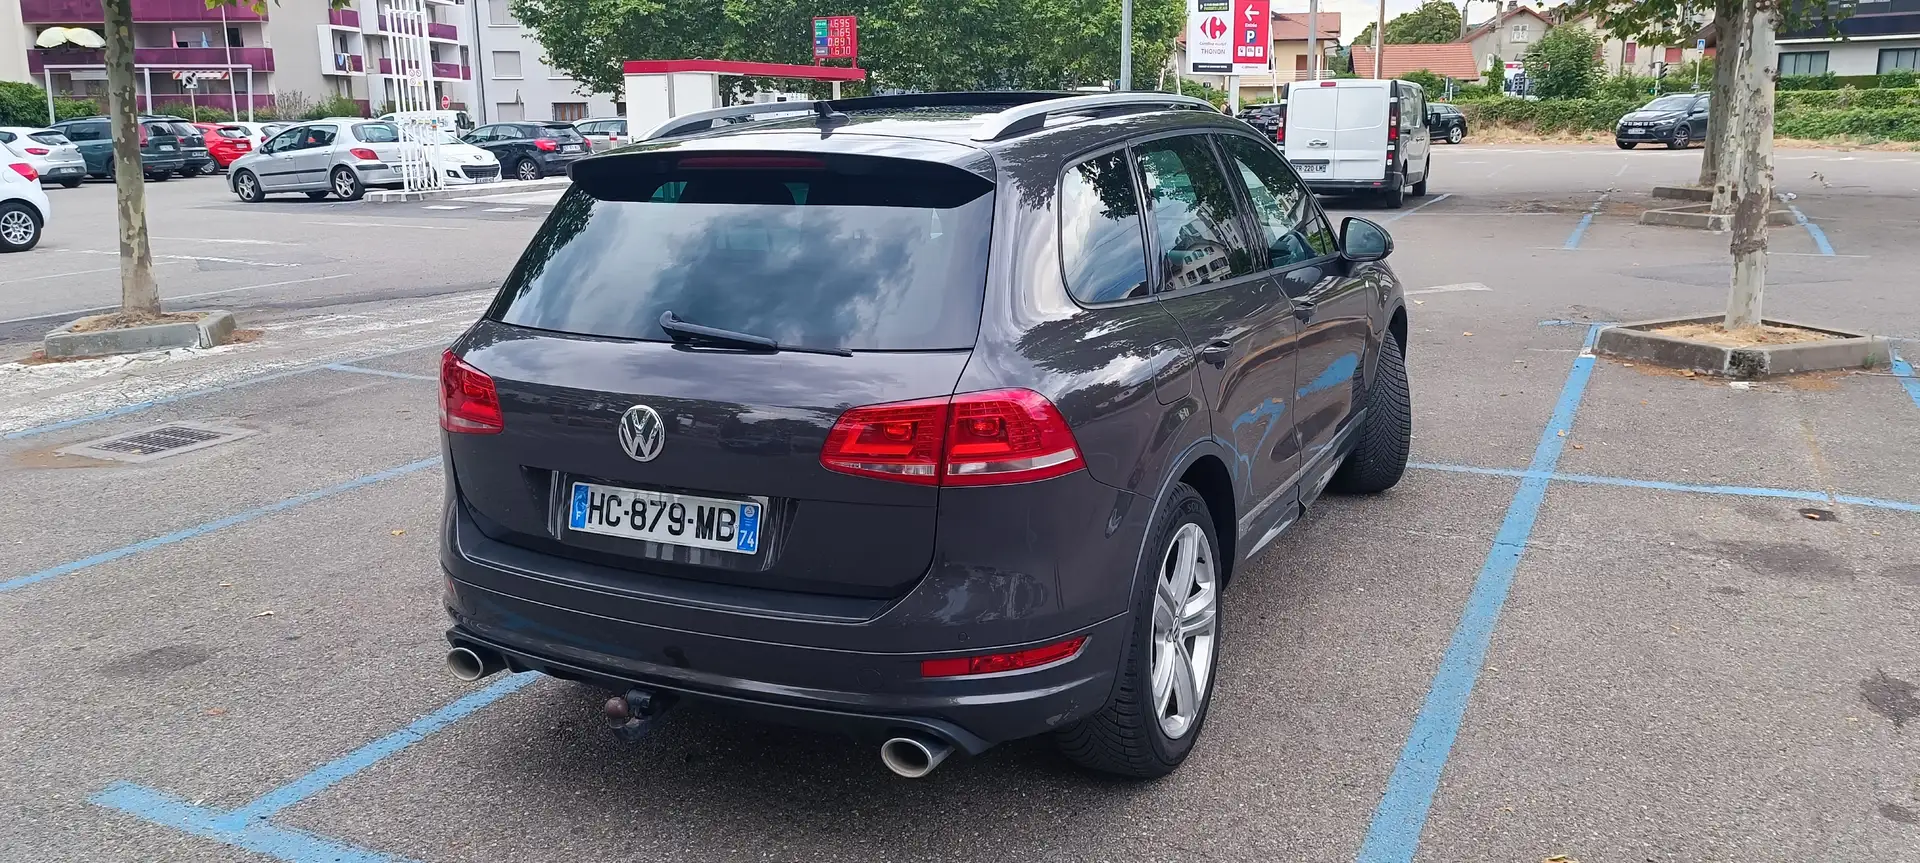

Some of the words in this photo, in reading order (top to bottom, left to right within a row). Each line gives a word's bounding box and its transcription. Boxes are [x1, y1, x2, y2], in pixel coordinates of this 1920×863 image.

[830, 19, 850, 28] 1.695
[1246, 30, 1255, 43] P
[575, 511, 582, 521] F
[588, 491, 737, 542] HC-879-MB
[739, 529, 755, 548] 74
